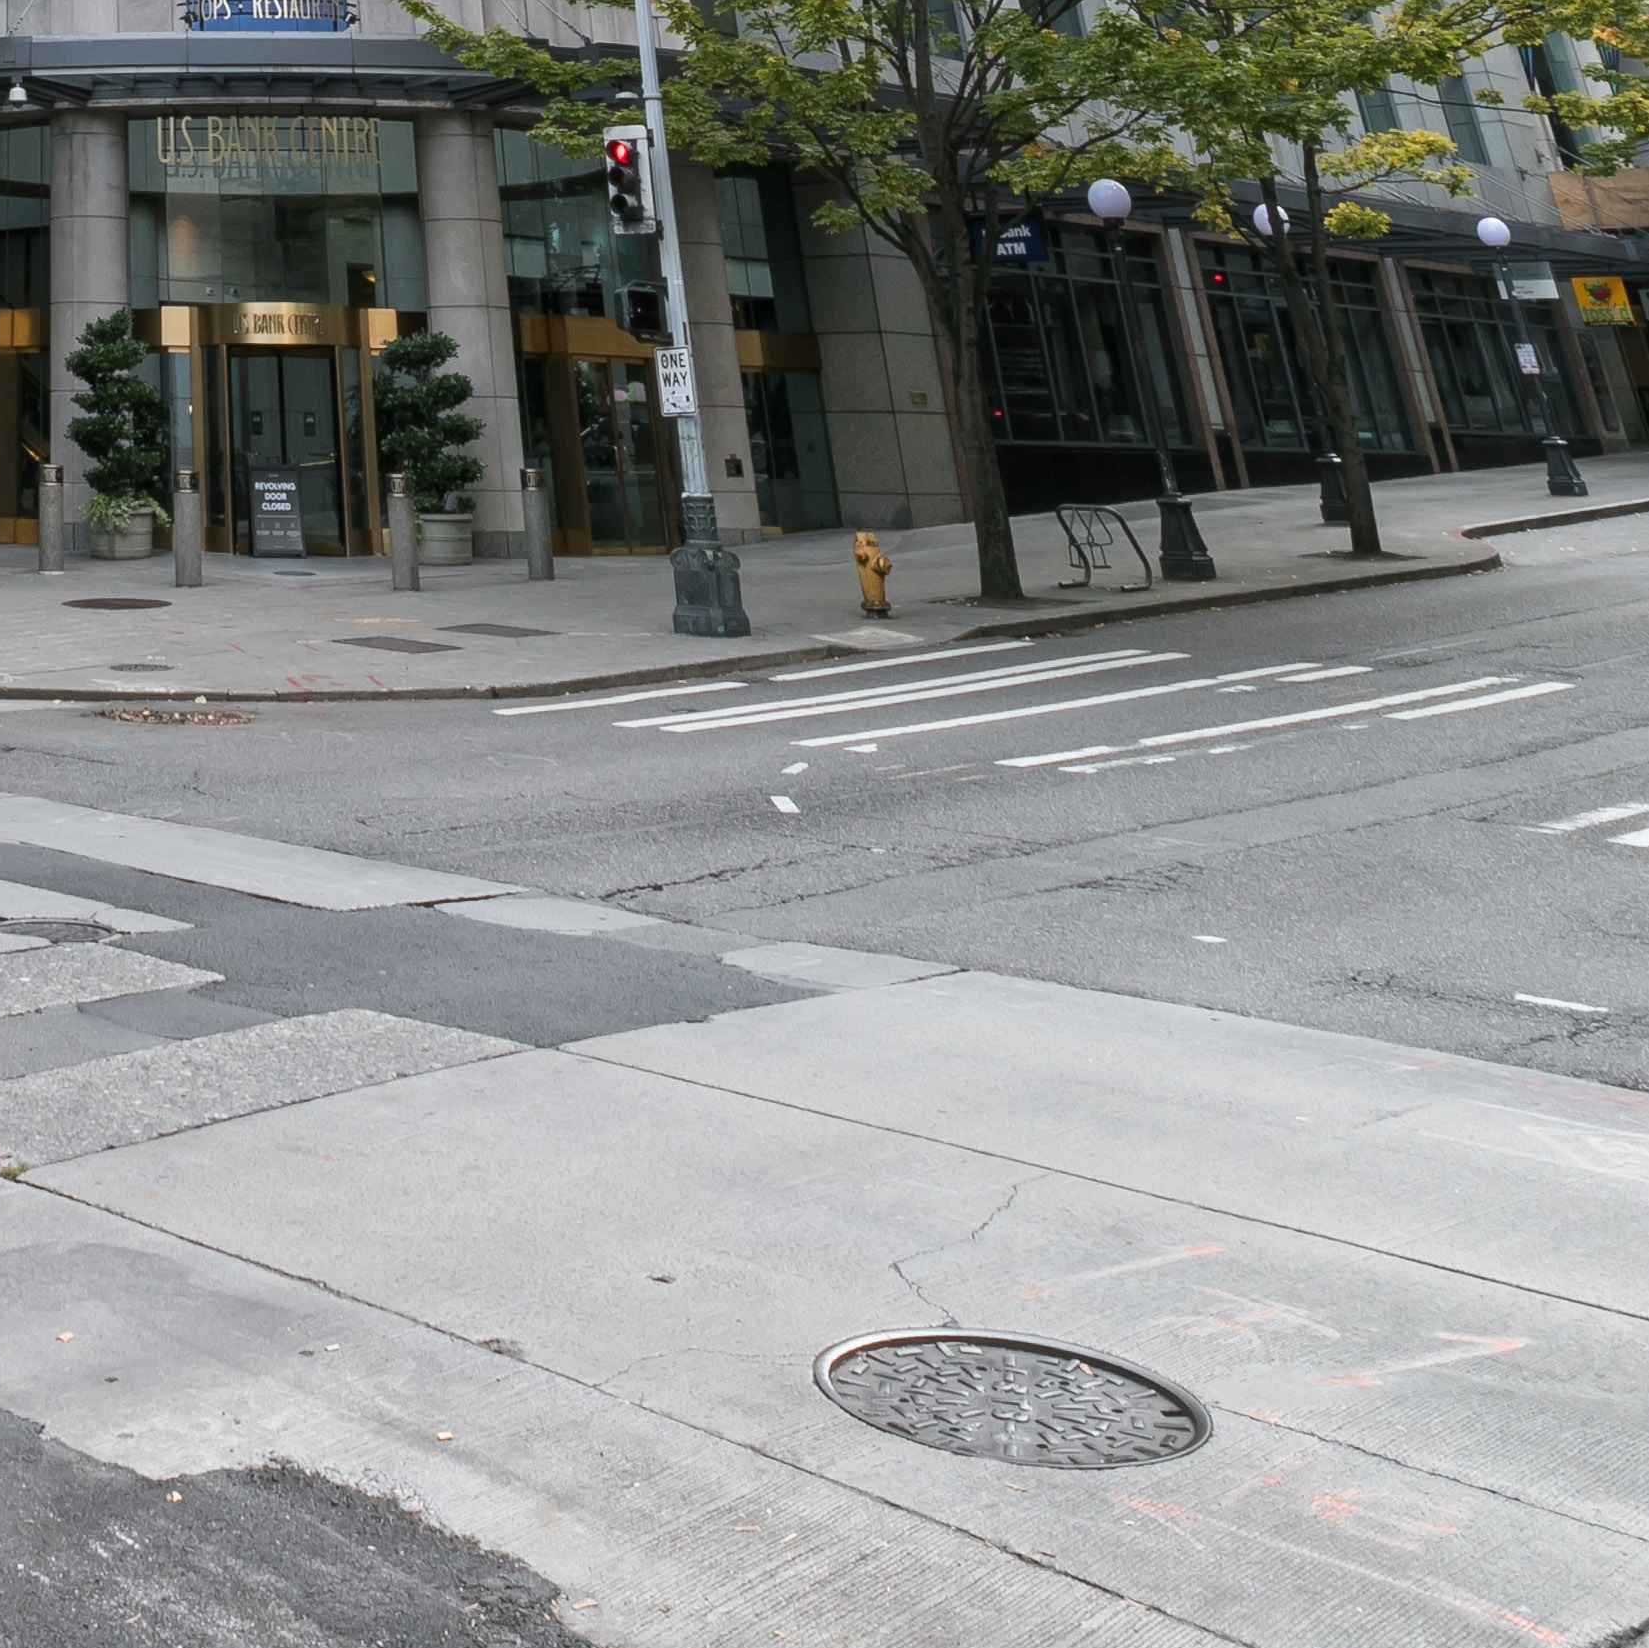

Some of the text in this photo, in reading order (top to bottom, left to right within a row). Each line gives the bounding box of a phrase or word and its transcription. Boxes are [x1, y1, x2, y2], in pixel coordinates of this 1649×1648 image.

[207, 115, 279, 164] BANK
[290, 115, 381, 166] CENTRE
[997, 241, 1027, 256] ATM
[253, 313, 285, 335] BANK
[661, 353, 686, 369] ONE
[662, 371, 688, 388] WAY
[255, 482, 296, 491] REVOLVING
[264, 492, 288, 501] DOOR
[261, 502, 292, 511] CLOSED
